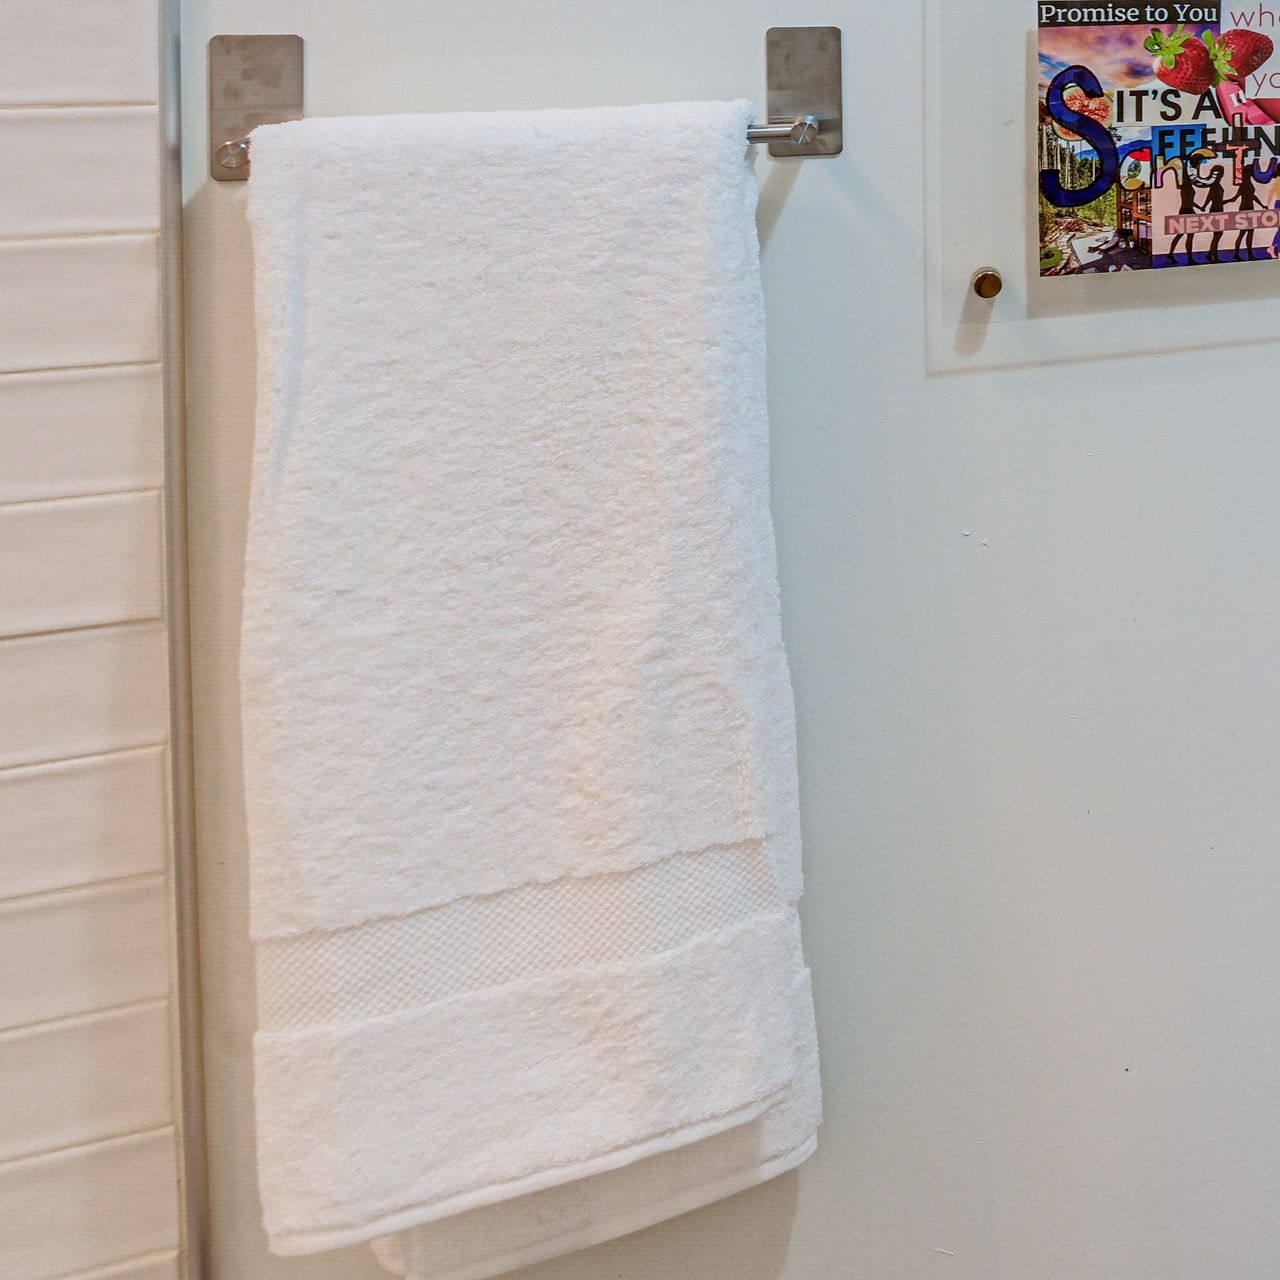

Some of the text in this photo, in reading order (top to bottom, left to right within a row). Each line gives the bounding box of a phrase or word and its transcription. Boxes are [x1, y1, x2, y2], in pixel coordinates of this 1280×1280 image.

[1040, 3, 1218, 24] Promise to You
[1115, 89, 1222, 123] IT'S A
[1168, 213, 1233, 235] NEXT
